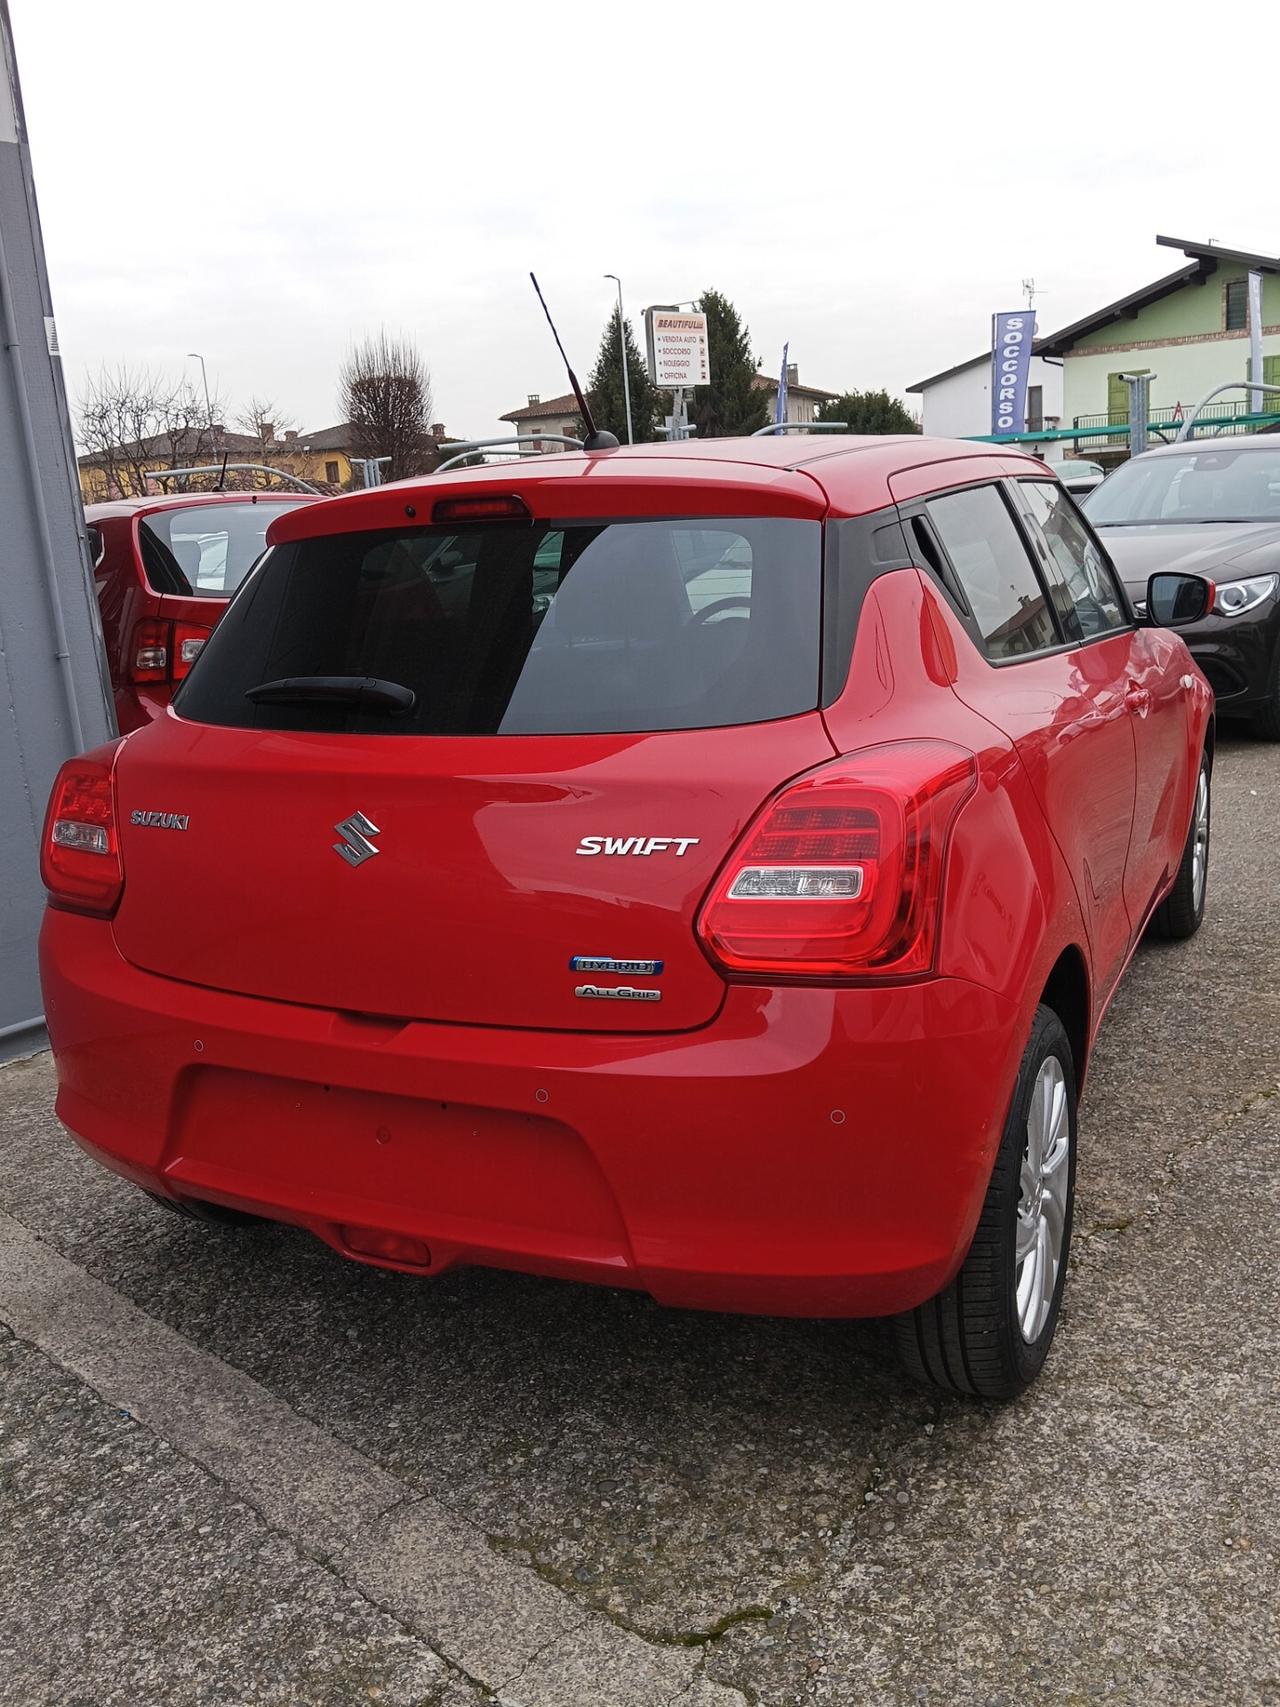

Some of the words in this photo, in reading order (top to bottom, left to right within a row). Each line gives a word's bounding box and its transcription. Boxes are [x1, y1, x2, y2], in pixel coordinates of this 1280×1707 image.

[657, 319, 698, 329] BEAUTIFUL
[661, 335, 683, 344] VENDITA
[683, 336, 697, 344] AUTO
[662, 347, 691, 355] SOCCORSO
[663, 360, 690, 368] NOLEGGIO
[664, 372, 688, 380] OFFICINA
[997, 317, 1024, 428] SOCCORSO
[130, 809, 190, 831] SUZUKI
[575, 836, 700, 856] SWIFT
[581, 960, 649, 971] HYBRID
